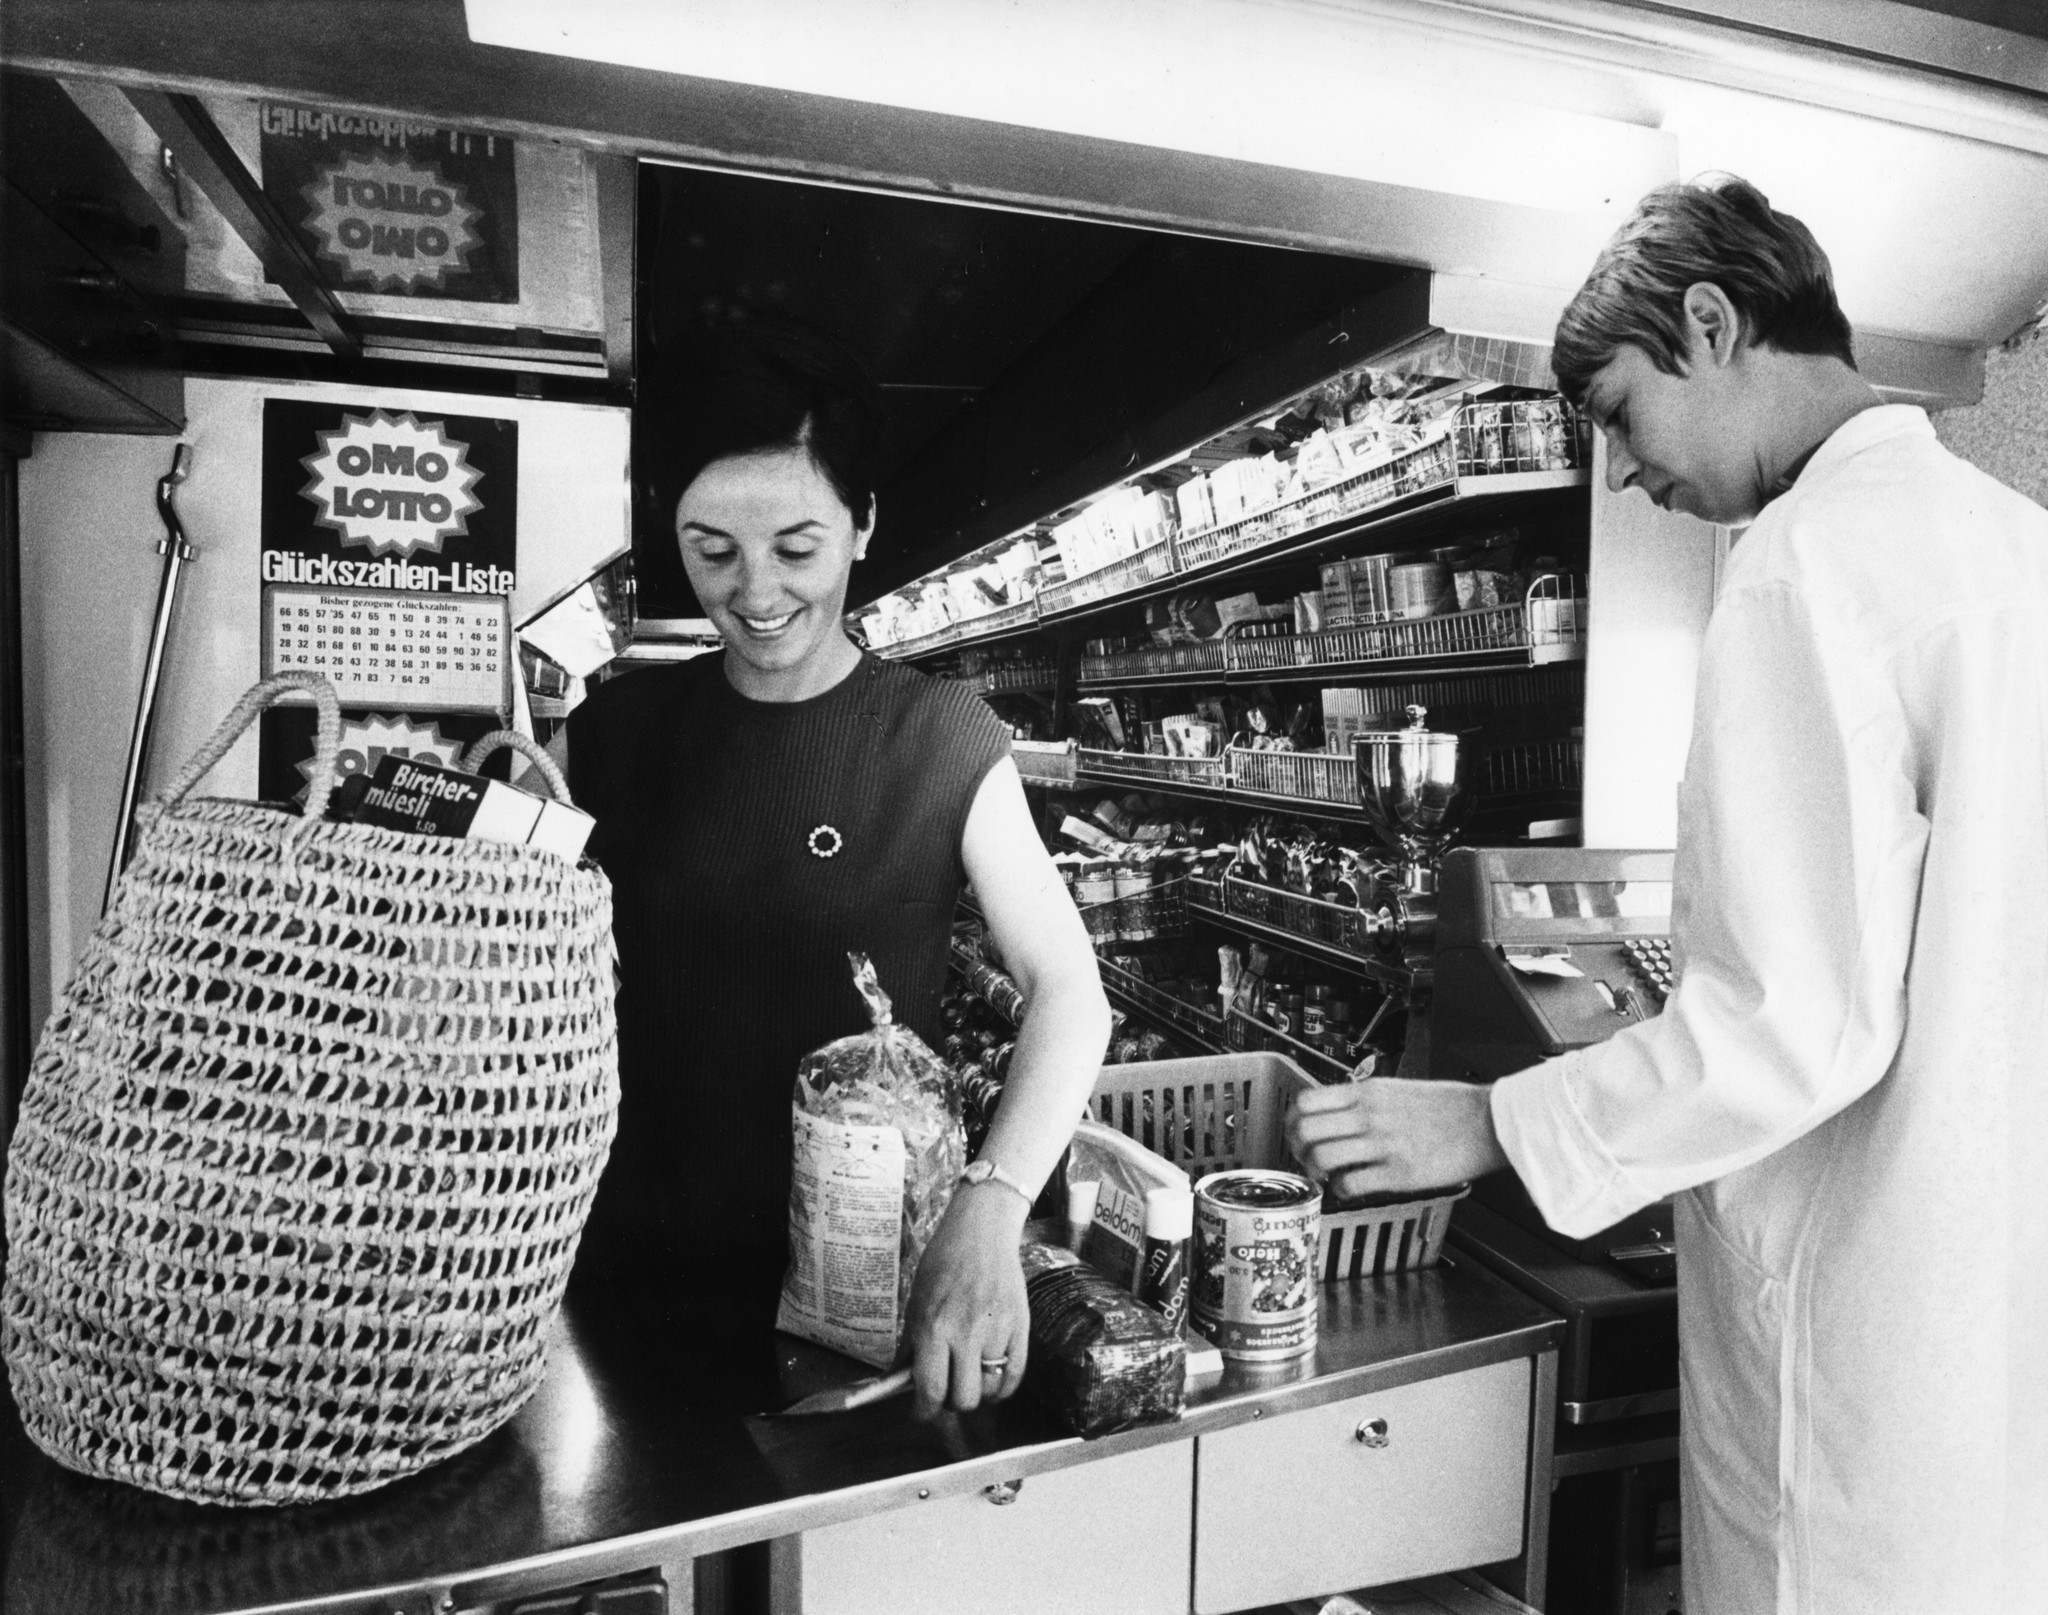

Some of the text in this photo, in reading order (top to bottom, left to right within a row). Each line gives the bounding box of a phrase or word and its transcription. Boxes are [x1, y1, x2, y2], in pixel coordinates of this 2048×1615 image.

[337, 443, 449, 483] OMO
[333, 486, 452, 523] LOTTO
[262, 550, 514, 595] Glückszahlen-Liste
[320, 596, 350, 606] Bisher
[352, 599, 394, 609] gezogene
[279, 607, 498, 627] 66 85 57 35 47 65 11 50 8 39 74 6 23
[281, 623, 292, 632] 19
[297, 623, 309, 633] 40
[317, 624, 326, 634] 51
[332, 625, 344, 635] 80
[350, 626, 362, 636] 88
[368, 627, 380, 636] 30
[390, 628, 396, 637] 9
[404, 629, 414, 638] 13
[419, 630, 430, 638] 24
[436, 631, 448, 639] 44
[459, 632, 463, 640] 1
[487, 633, 497, 642] 56
[279, 638, 291, 648] 28
[297, 639, 309, 649] 32
[316, 640, 326, 649] 81
[332, 641, 344, 650] 68
[352, 642, 362, 651] 61
[385, 643, 397, 652] 84
[402, 644, 413, 653] 63
[436, 646, 447, 655] 59
[453, 647, 465, 656] 90
[470, 647, 481, 656] 37
[486, 648, 497, 657] 82
[280, 654, 291, 664] 76
[296, 655, 309, 664] 42
[314, 655, 326, 665] 54
[332, 656, 344, 666] 26
[349, 657, 361, 666] 43
[369, 658, 379, 667] 72
[402, 660, 413, 669] 58
[436, 661, 447, 670] 89
[470, 662, 481, 672] 36
[486, 663, 497, 672] 52
[334, 672, 343, 681] 12
[353, 672, 361, 681] 71
[367, 673, 378, 682] 83
[390, 674, 395, 682] 7
[401, 675, 413, 684] 64
[418, 676, 430, 684] 29
[391, 764, 478, 802] Bircher-
[364, 786, 432, 818] müesli
[1094, 1180, 1141, 1243] beldam
[1238, 1247, 1281, 1262] Hero
